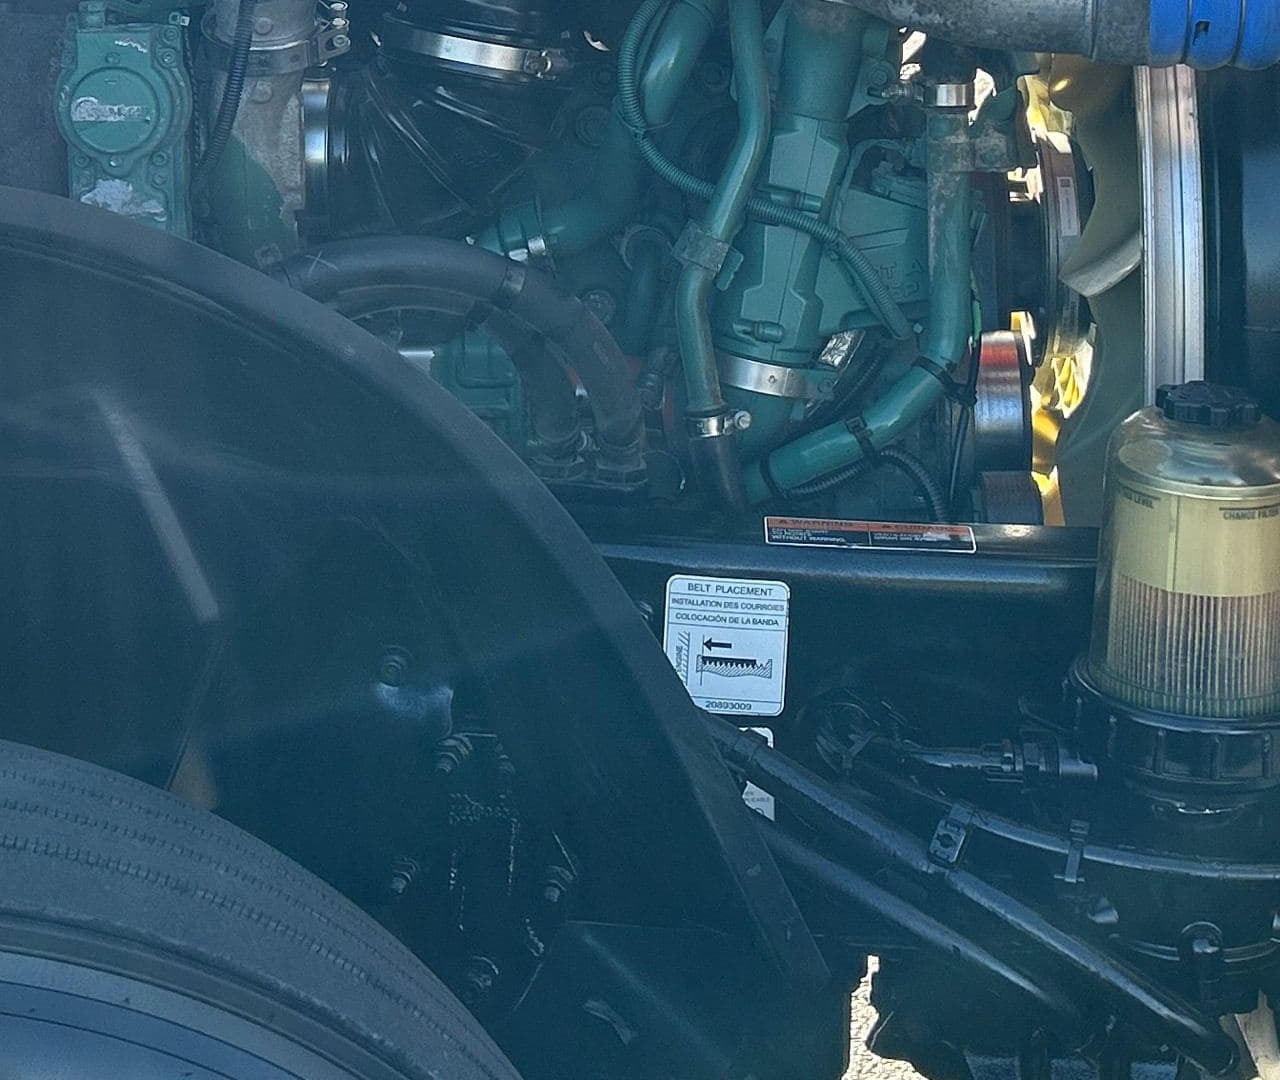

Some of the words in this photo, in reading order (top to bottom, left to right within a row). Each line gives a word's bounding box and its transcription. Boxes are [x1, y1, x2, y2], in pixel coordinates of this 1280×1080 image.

[1223, 511, 1256, 520] CHANGE
[687, 582, 711, 593] BELT
[715, 585, 774, 597] PLACEMENT
[672, 597, 722, 608] INSTALLATION
[724, 601, 739, 610] DES
[740, 603, 785, 612] COURROIES
[675, 611, 727, 623] COLOCACIÓN
[729, 616, 739, 624] DE
[741, 617, 751, 625] LA
[752, 618, 779, 626] BANDA
